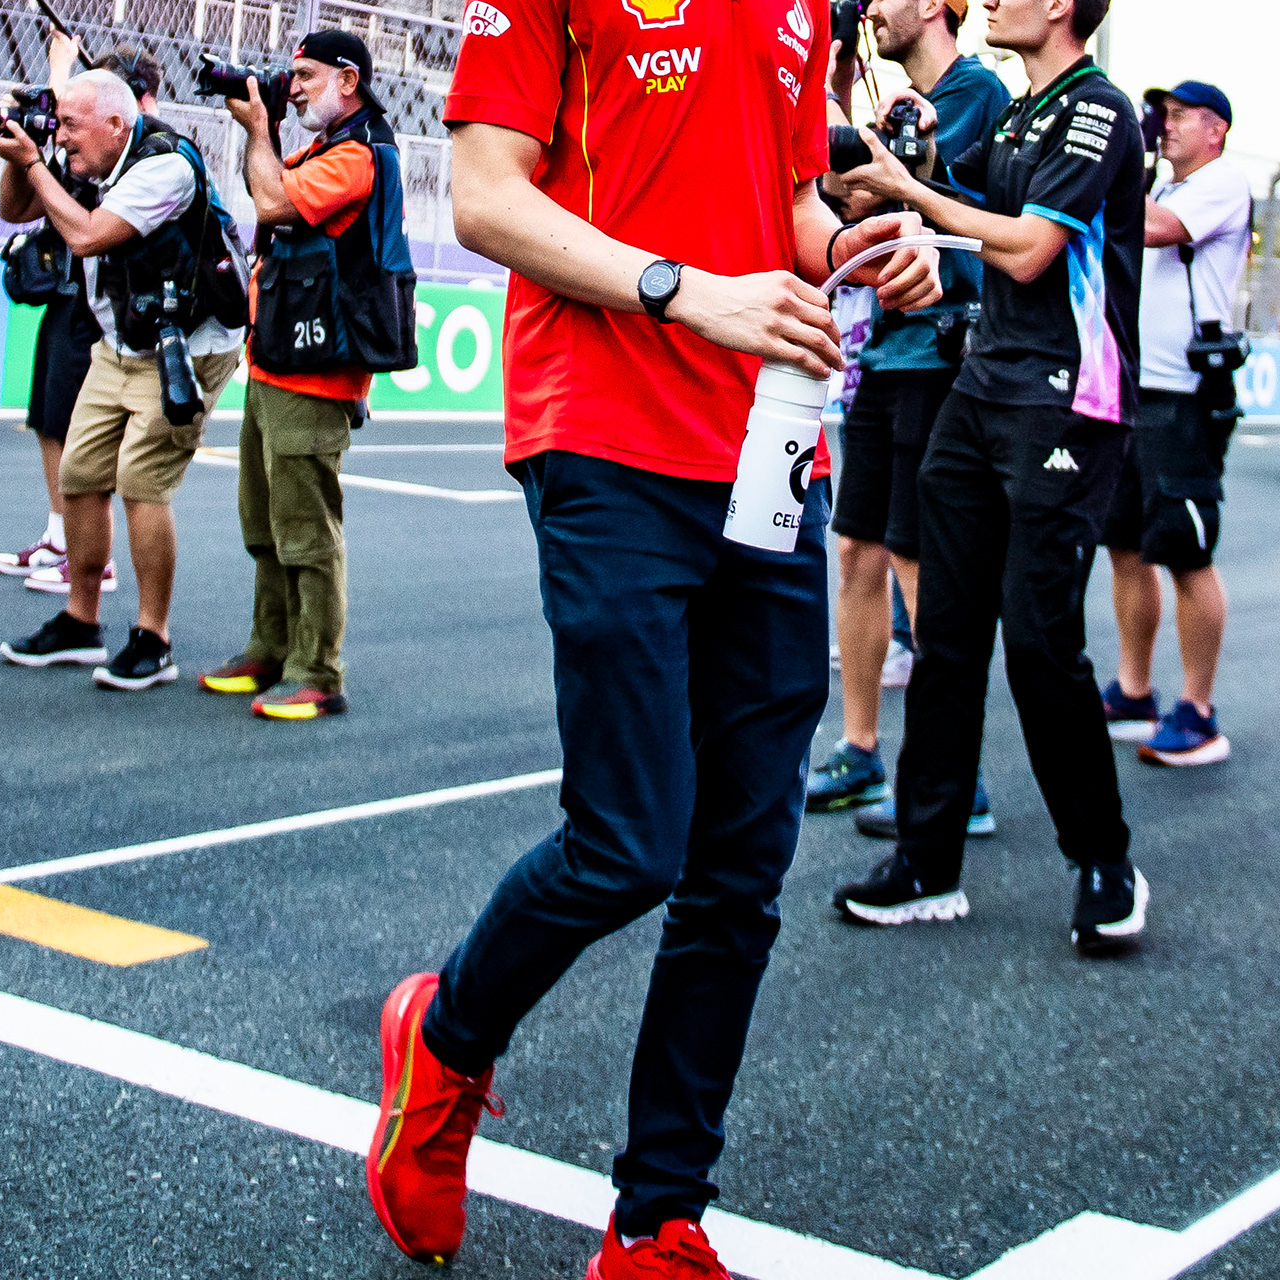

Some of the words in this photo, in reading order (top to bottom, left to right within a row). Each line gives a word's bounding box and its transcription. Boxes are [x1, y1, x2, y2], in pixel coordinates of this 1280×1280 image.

[626, 46, 702, 80] VGW
[645, 75, 688, 95] PLAY
[1087, 103, 1118, 123] BWT
[294, 317, 326, 350] 215
